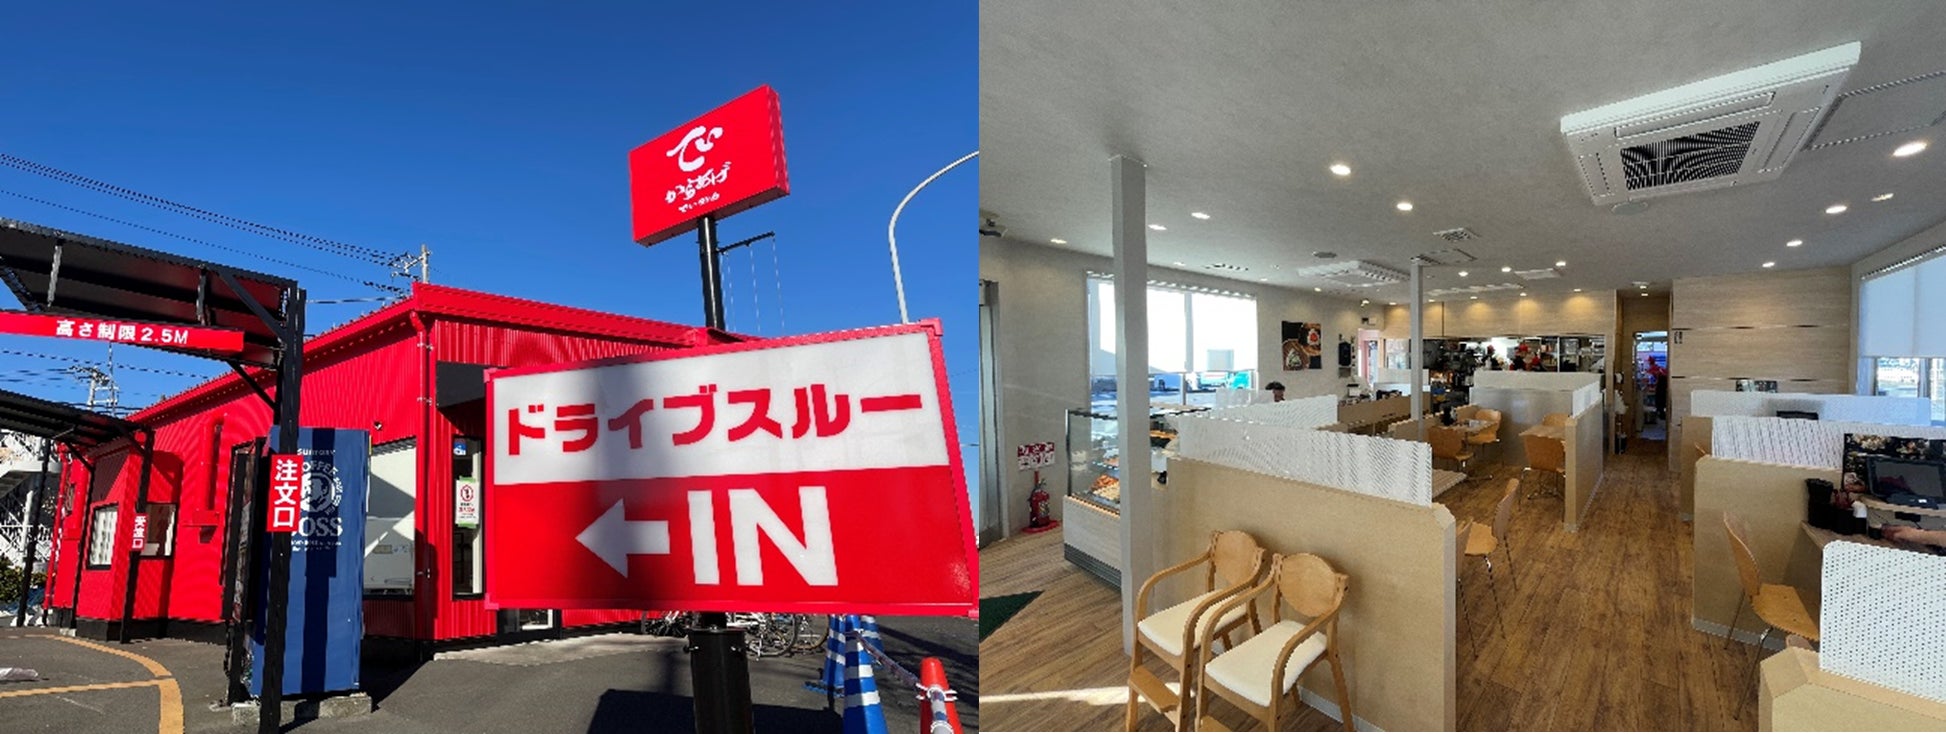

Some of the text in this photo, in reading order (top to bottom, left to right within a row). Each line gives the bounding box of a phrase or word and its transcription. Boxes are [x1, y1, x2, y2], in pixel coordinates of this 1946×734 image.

[508, 383, 922, 456] ドライブスルー
[272, 458, 299, 529] 注文口
[291, 516, 344, 537] OSS
[687, 486, 838, 587] IN
